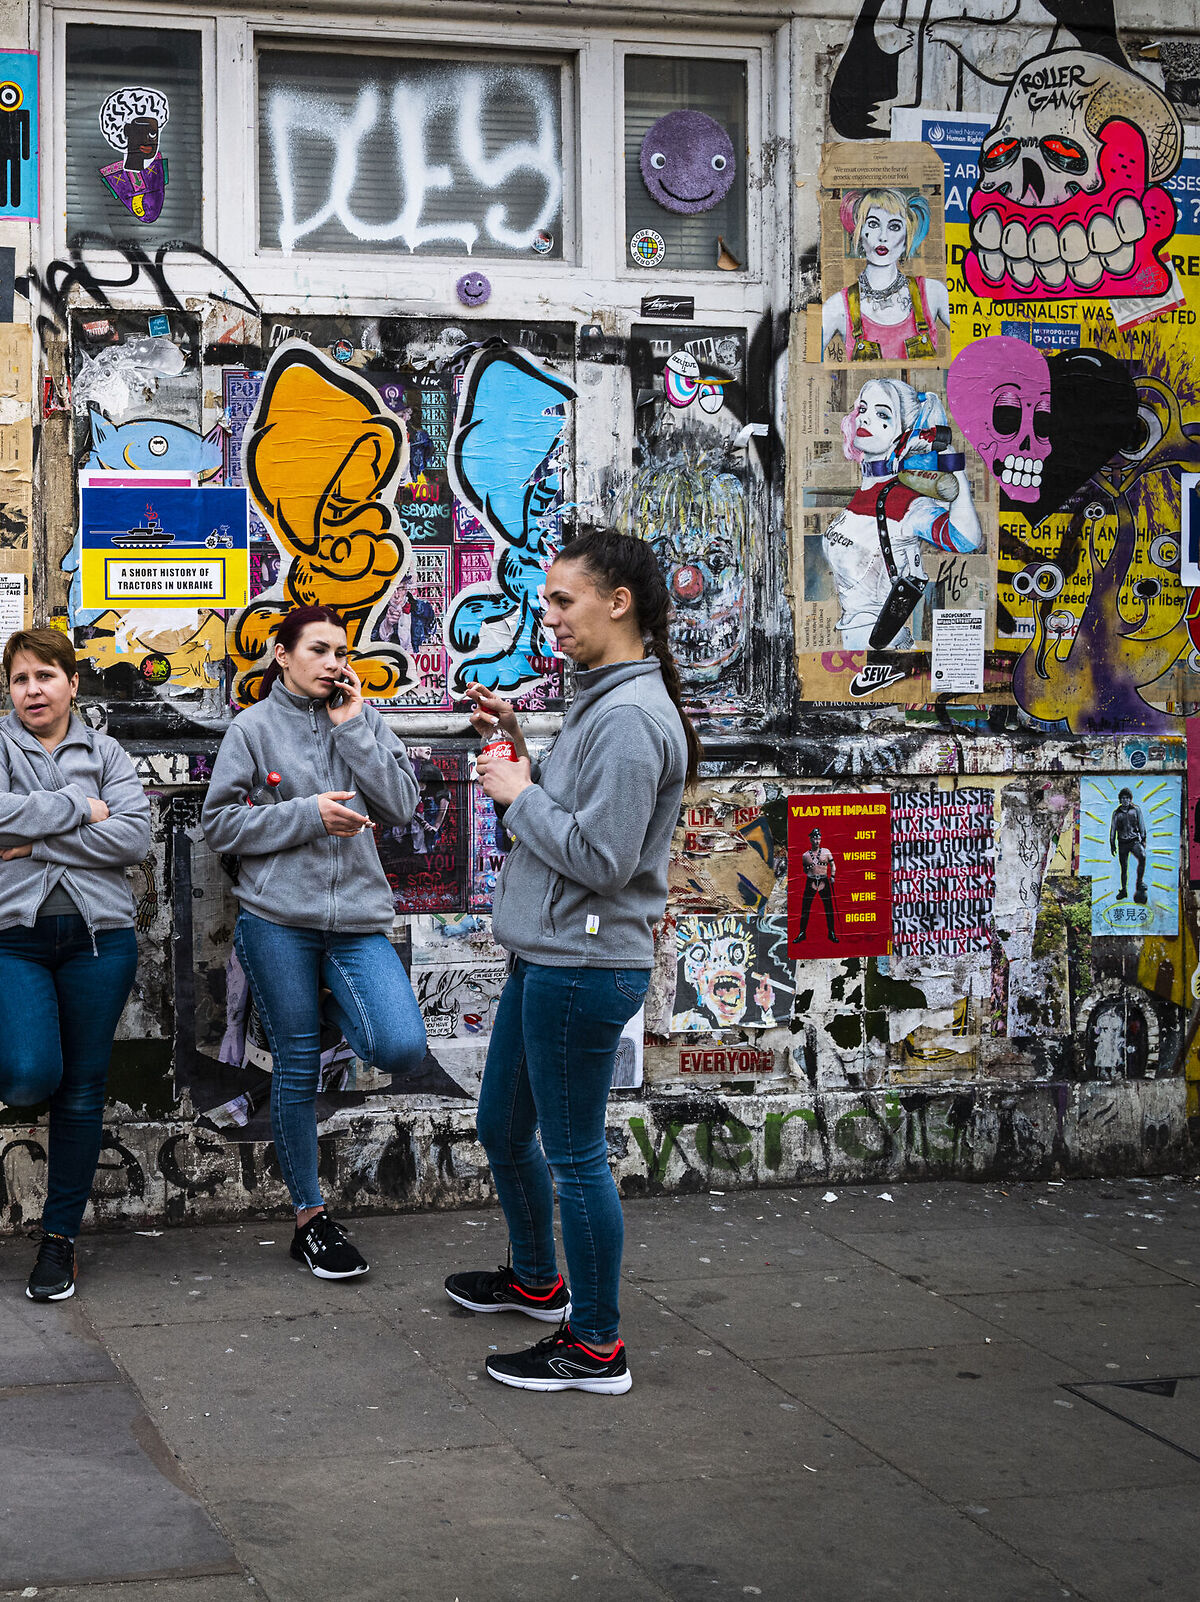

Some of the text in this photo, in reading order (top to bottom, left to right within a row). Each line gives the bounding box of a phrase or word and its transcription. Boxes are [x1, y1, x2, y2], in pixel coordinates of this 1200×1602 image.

[1019, 64, 1100, 95] ROLLER
[1027, 91, 1089, 112] GANG
[972, 302, 984, 315] A
[987, 302, 1078, 319] JOURNALIST
[1082, 306, 1115, 321] WAS
[973, 323, 991, 338] BY
[1089, 328, 1151, 345] IN A VAN
[1035, 336, 1078, 345] POLICE
[420, 392, 448, 405] MEN
[420, 408, 448, 421] MEN
[409, 483, 440, 501] YOU
[1031, 526, 1052, 539] OR
[416, 555, 443, 567] MEN
[461, 555, 490, 567] MEN
[121, 568, 209, 577] A SHORT HISTORY OF
[416, 571, 443, 583] MEN
[461, 570, 490, 583] MEN
[118, 580, 213, 590] TRACTORS IN UKRAINE
[412, 653, 441, 672] YOU
[861, 665, 892, 682] SEW
[791, 804, 887, 817] VLAD THE IMPALER
[854, 830, 877, 839] JUST
[424, 854, 455, 871] YOU
[843, 851, 877, 861] WISHES
[865, 871, 877, 880] HE
[851, 892, 877, 902] WERE
[845, 913, 877, 923] BIGGER
[680, 1052, 773, 1073] EVERYONE
